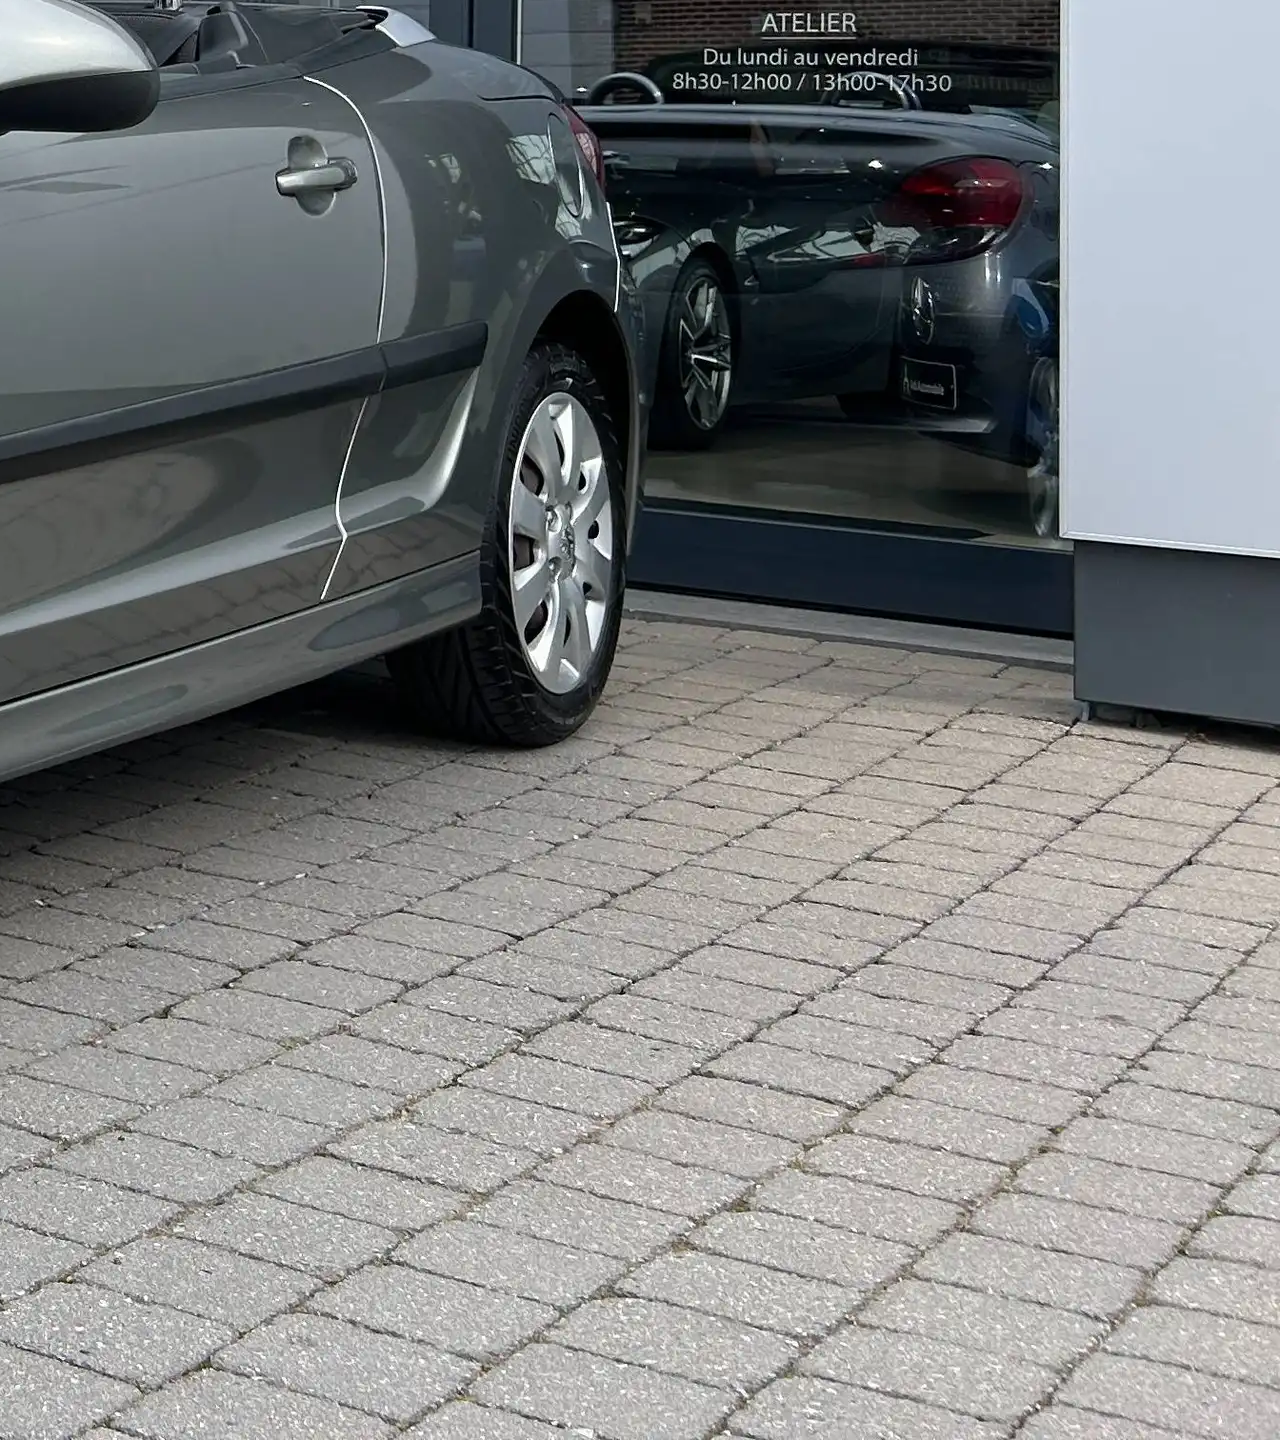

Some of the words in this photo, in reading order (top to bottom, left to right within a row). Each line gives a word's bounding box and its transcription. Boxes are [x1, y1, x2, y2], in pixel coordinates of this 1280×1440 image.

[761, 12, 857, 33] ATELIER
[703, 48, 731, 66] Du
[737, 47, 788, 66] lundi
[793, 50, 819, 66] au
[824, 48, 918, 66] vendredi
[672, 72, 791, 91] 8h30-12h00
[795, 72, 807, 92] /
[812, 73, 952, 92] 13h00-17h30
